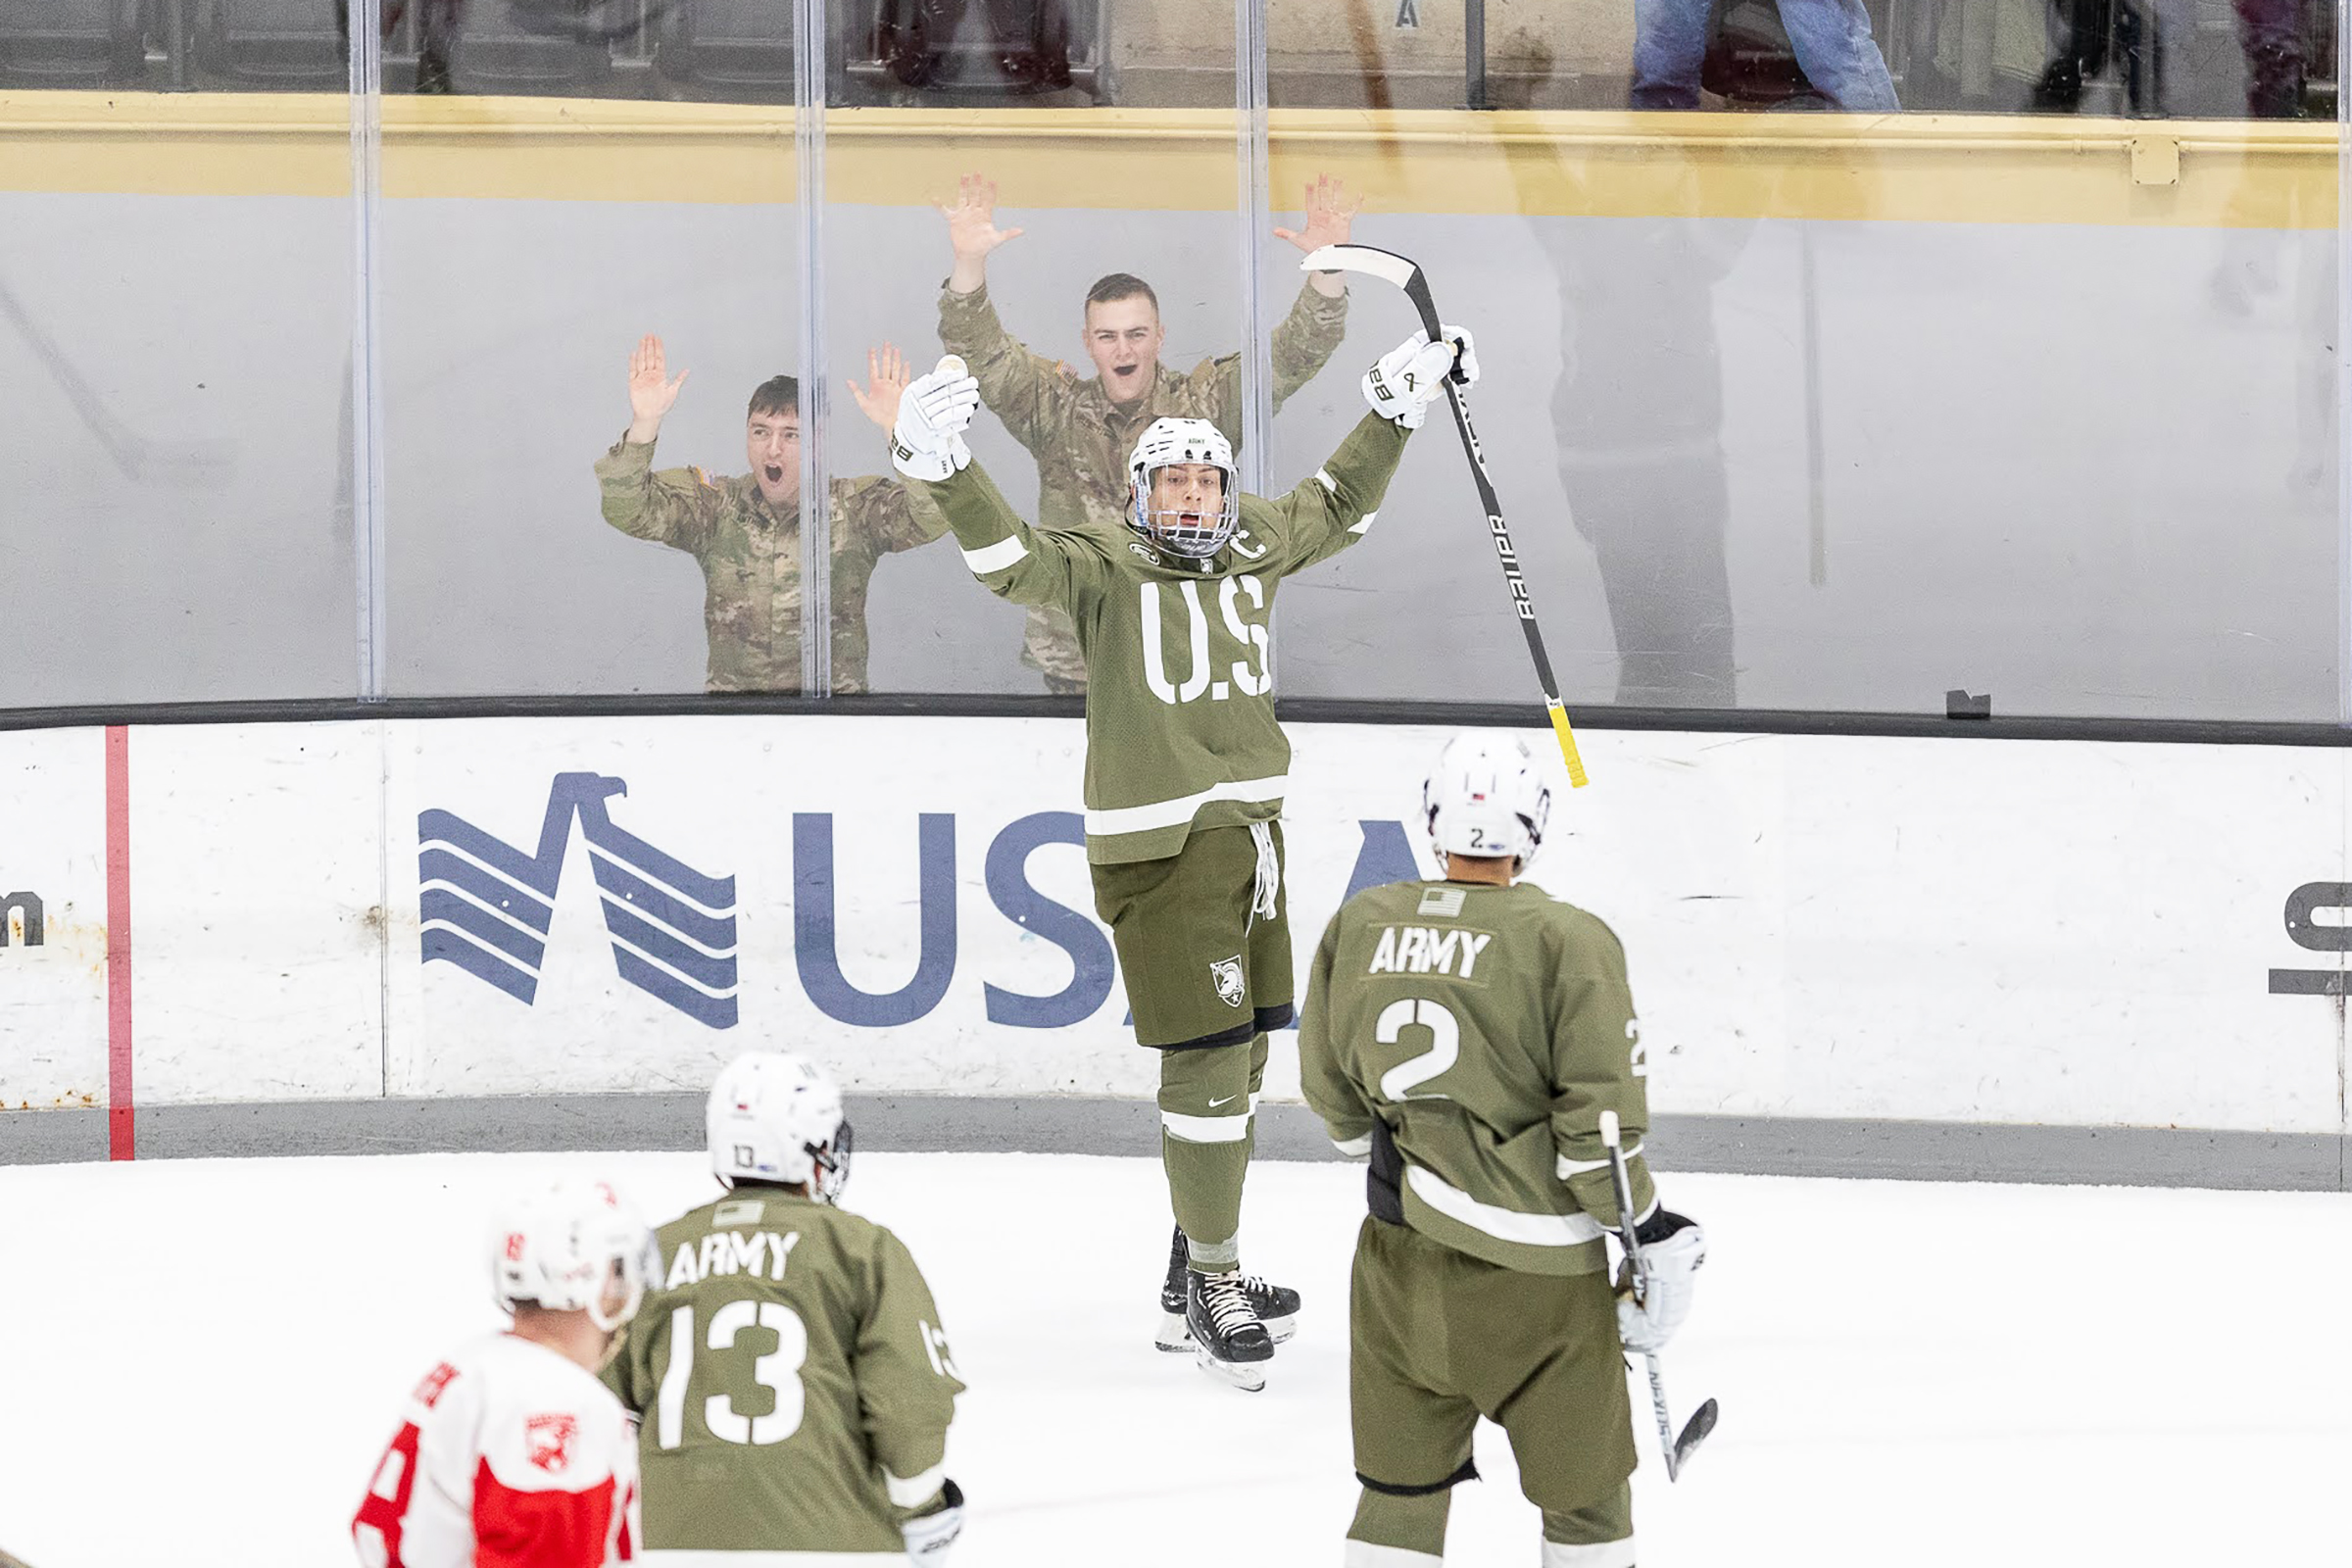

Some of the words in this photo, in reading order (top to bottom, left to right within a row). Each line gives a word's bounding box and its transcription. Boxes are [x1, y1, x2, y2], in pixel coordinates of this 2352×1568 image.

[1395, 0, 1418, 27] A
[1229, 530, 1267, 560] C
[1471, 828, 1484, 849] 2
[1368, 926, 1493, 978] ARMY
[1375, 998, 1460, 1103] 2
[664, 1230, 801, 1292] ARMY
[658, 1299, 808, 1450] 13
